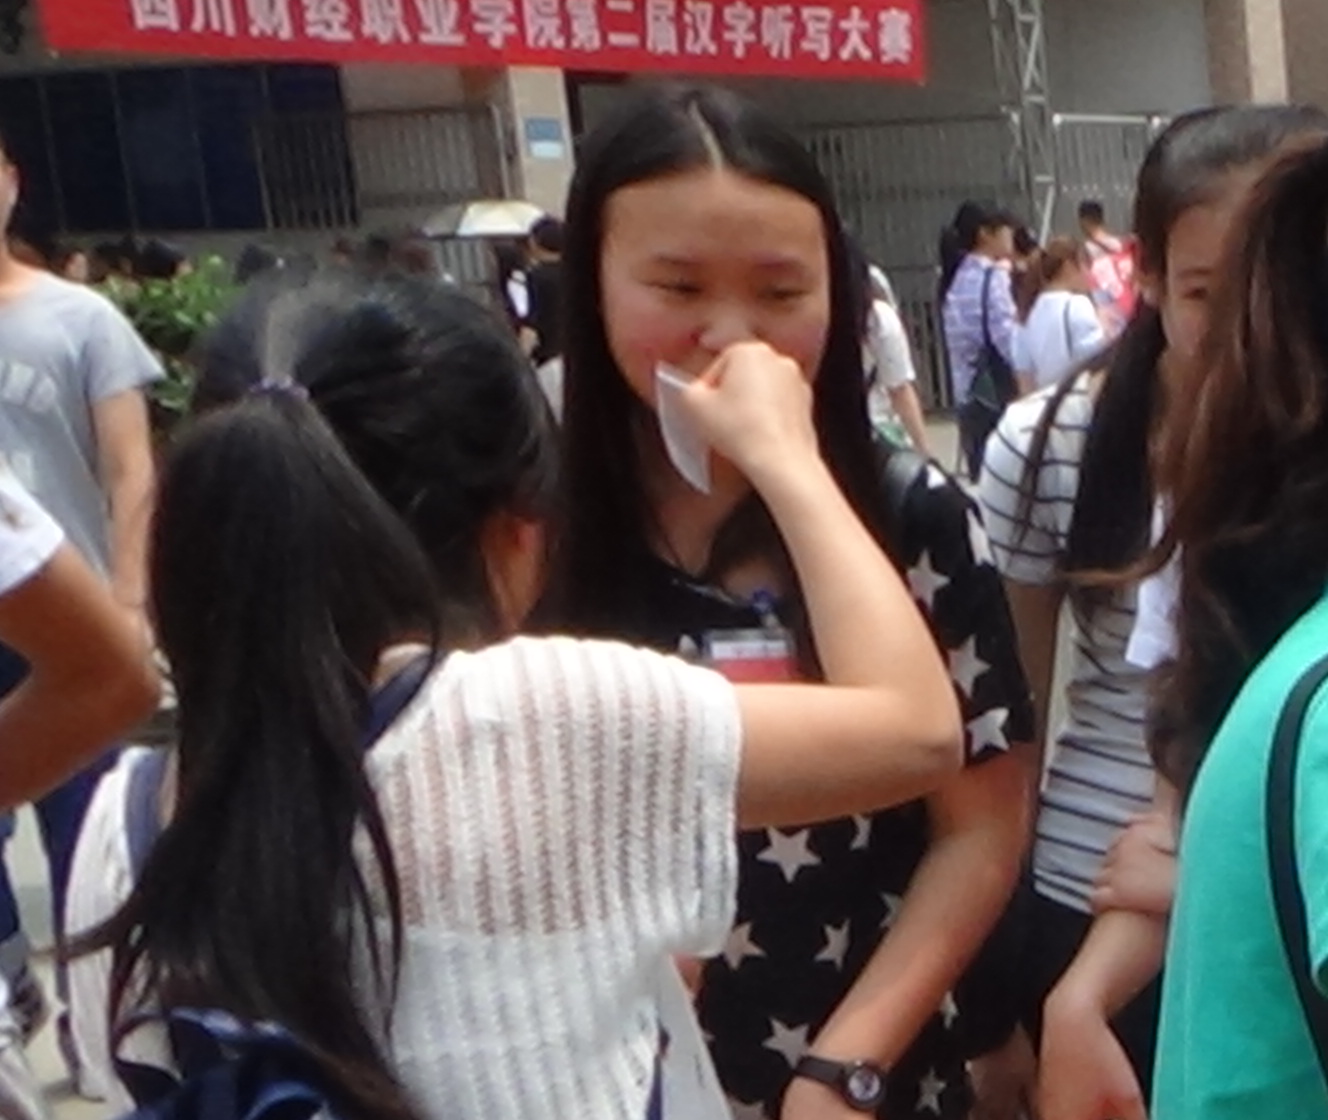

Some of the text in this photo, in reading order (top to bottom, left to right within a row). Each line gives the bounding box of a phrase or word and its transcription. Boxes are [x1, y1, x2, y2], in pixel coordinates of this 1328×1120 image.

[132, 0, 913, 63] 四川财经职业学院第二届汉字听写大赛
